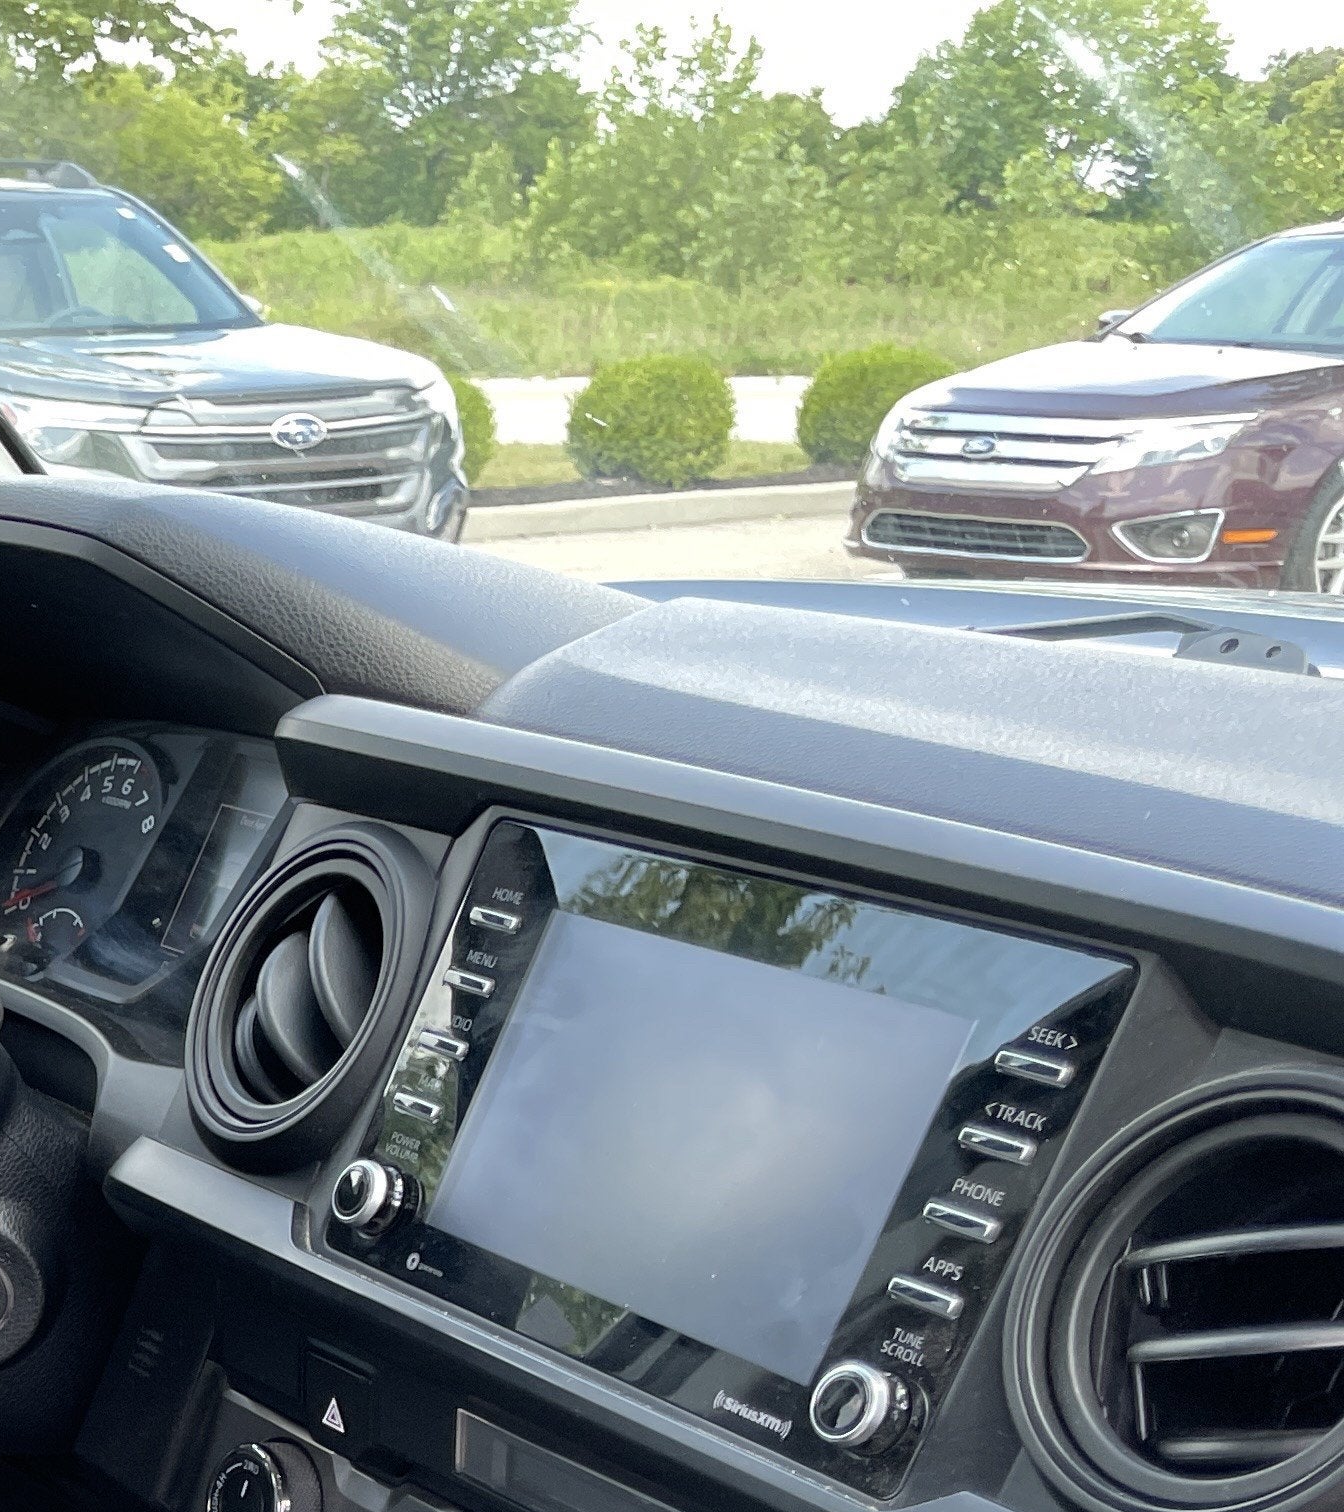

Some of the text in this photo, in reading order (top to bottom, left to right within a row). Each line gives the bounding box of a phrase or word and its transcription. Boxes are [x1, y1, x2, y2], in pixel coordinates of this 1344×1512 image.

[80, 785, 91, 802] 4
[101, 776, 115, 793] 5
[121, 778, 135, 795] 6
[135, 790, 149, 806] 7
[58, 805, 70, 823] 3
[141, 815, 155, 834] 8
[38, 833, 52, 850] 2
[491, 887, 524, 905] HOME
[466, 950, 498, 969] MENU
[391, 1131, 421, 1151] POWER
[385, 1144, 419, 1164] VOLUME
[951, 1178, 1007, 1207] PHONE
[922, 1256, 964, 1281] APPS
[892, 1327, 925, 1350] TUNE
[880, 1340, 925, 1367] SCROLL
